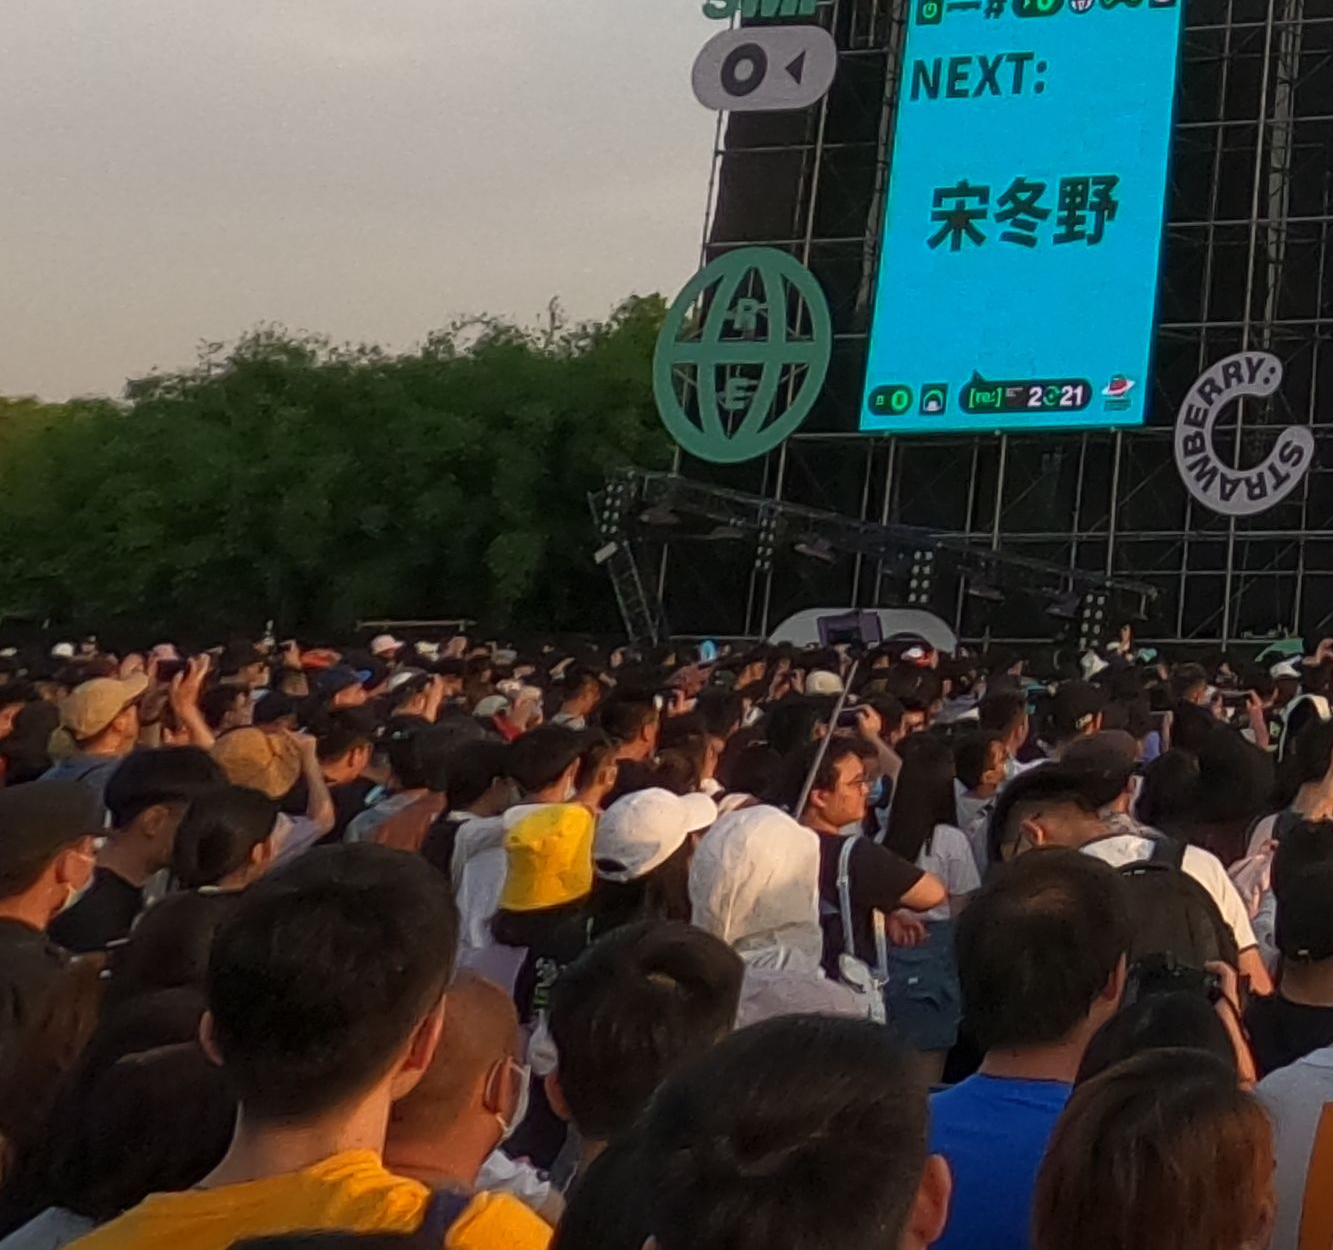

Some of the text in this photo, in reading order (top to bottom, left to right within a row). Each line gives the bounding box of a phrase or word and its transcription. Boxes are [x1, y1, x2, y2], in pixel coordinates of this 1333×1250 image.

[910, 52, 1047, 102] NEXT:
[927, 174, 1120, 252] 宋冬野
